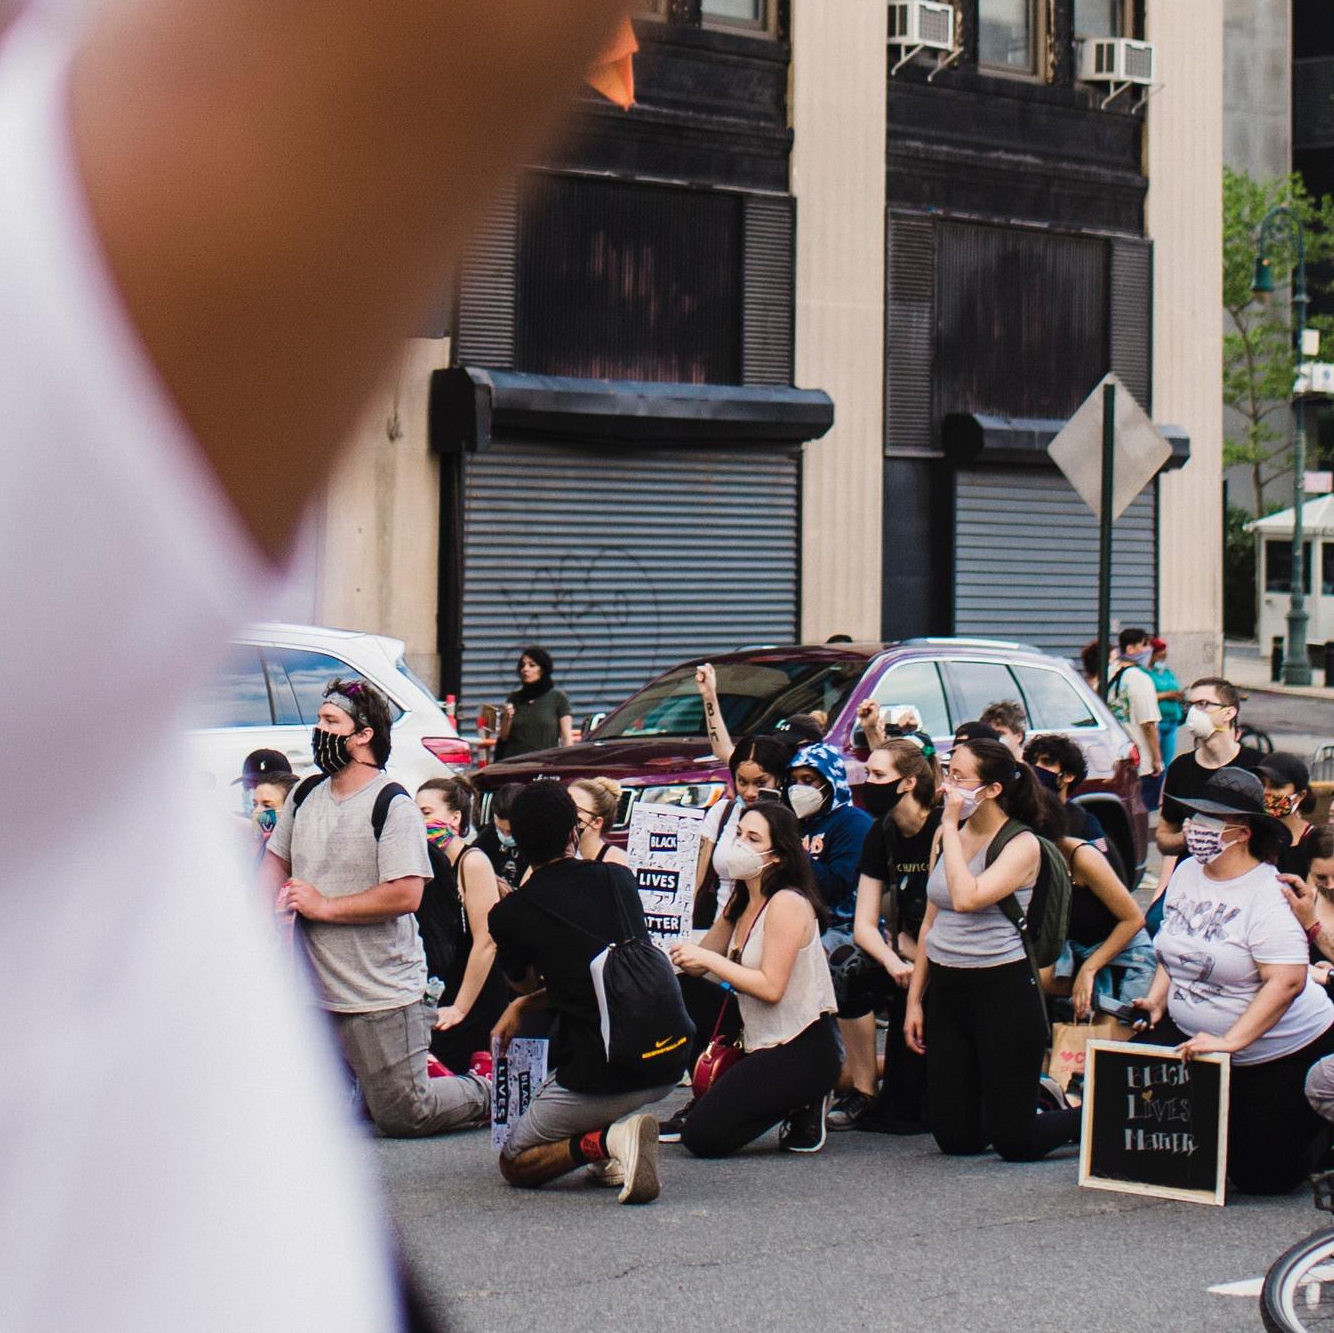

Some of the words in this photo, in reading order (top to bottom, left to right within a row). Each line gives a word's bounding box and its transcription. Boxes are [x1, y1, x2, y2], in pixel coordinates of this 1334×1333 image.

[650, 835, 677, 848] BLACK
[639, 873, 676, 889] LIVES
[643, 917, 680, 932] TTER
[498, 1065, 507, 1120] LIVES
